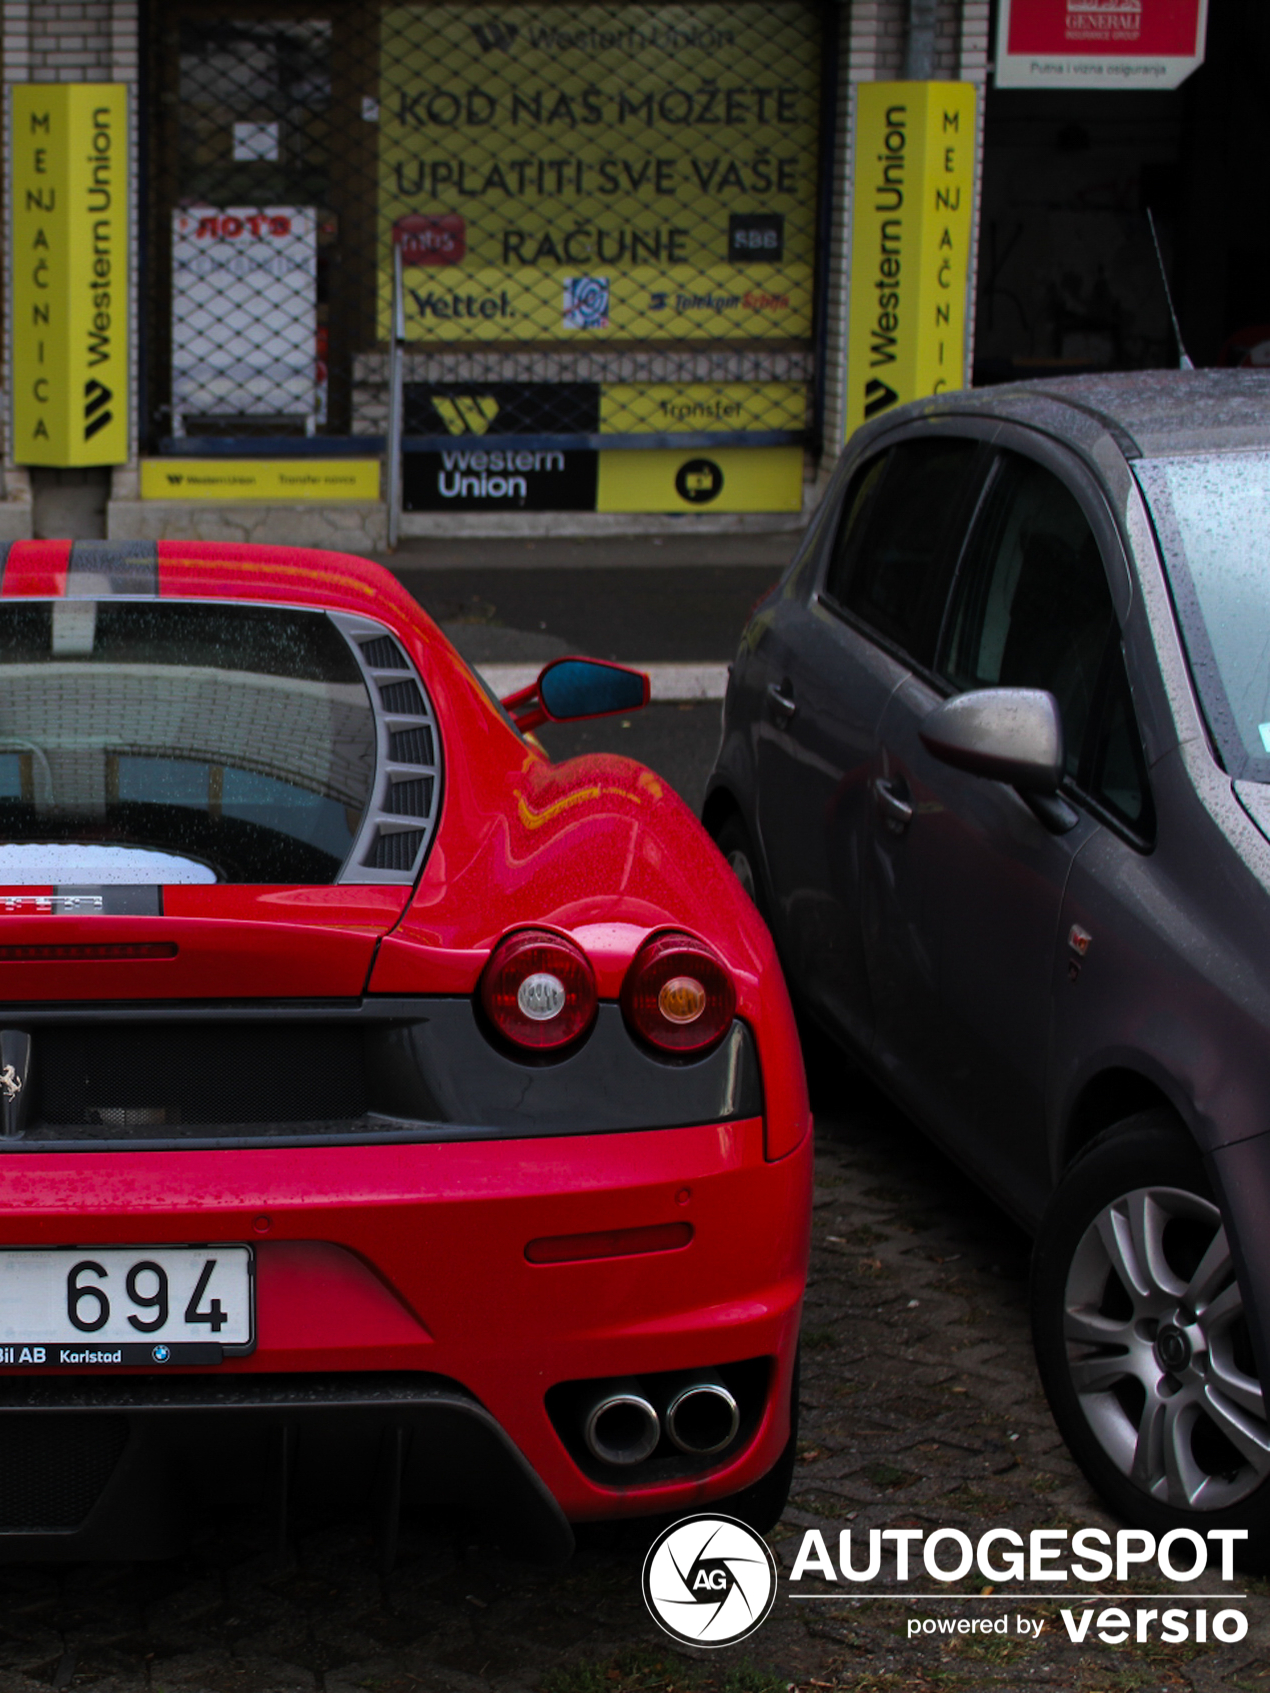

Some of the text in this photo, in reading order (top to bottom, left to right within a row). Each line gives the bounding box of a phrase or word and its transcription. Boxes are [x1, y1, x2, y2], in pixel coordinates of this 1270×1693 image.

[1065, 14, 1140, 30] GENERALI
[1031, 62, 1064, 74] Putna
[1073, 63, 1103, 74] vizna
[1106, 63, 1166, 78] osiguranja
[398, 80, 801, 126] KOD NAS MOŽETE
[396, 149, 800, 197] UPLATITI SVE VAŠE
[86, 106, 112, 368] Western Union
[502, 221, 690, 265] RAČUNE
[869, 104, 907, 368] Western Union
[658, 398, 745, 420] Transfer
[442, 450, 565, 473] Western
[437, 471, 527, 499] Union
[66, 1259, 228, 1333] 694
[18, 1347, 46, 1363] AB
[59, 1348, 122, 1363] Karlstad
